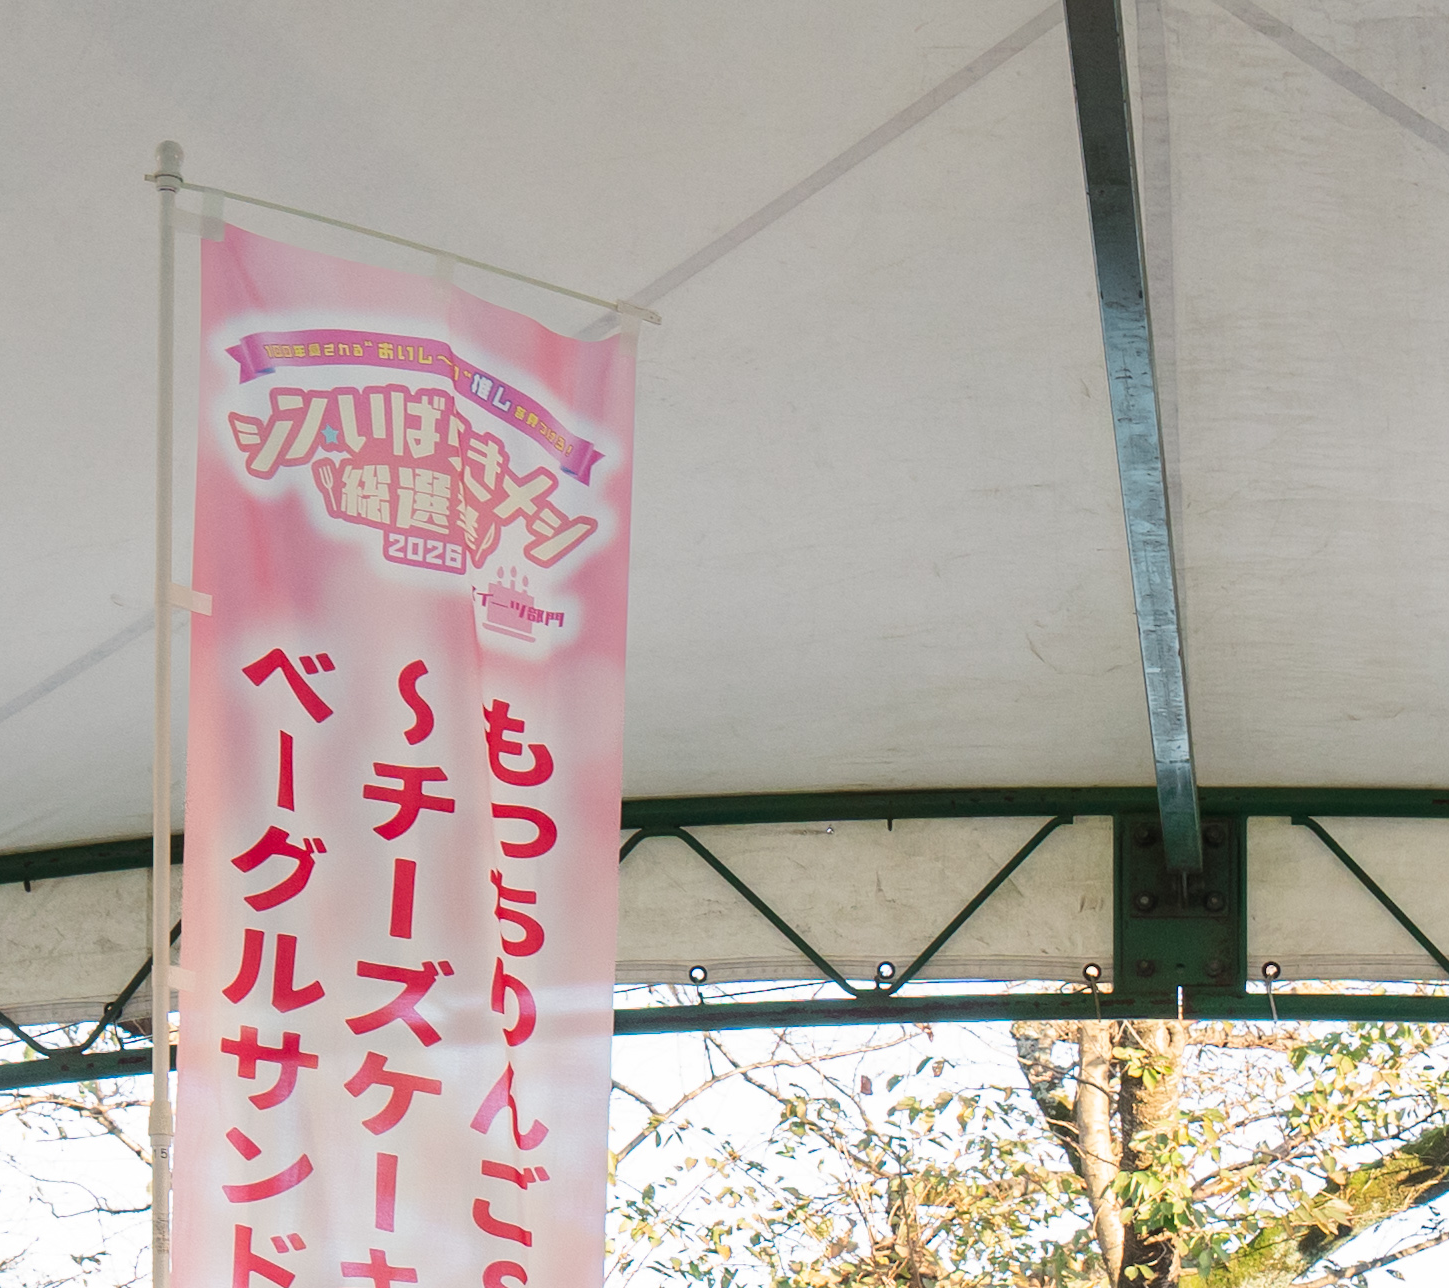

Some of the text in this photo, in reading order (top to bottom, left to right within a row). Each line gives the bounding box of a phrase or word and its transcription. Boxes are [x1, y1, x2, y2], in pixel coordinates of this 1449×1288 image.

[388, 534, 462, 568] 2026
[472, 585, 565, 627] イーツ部門
